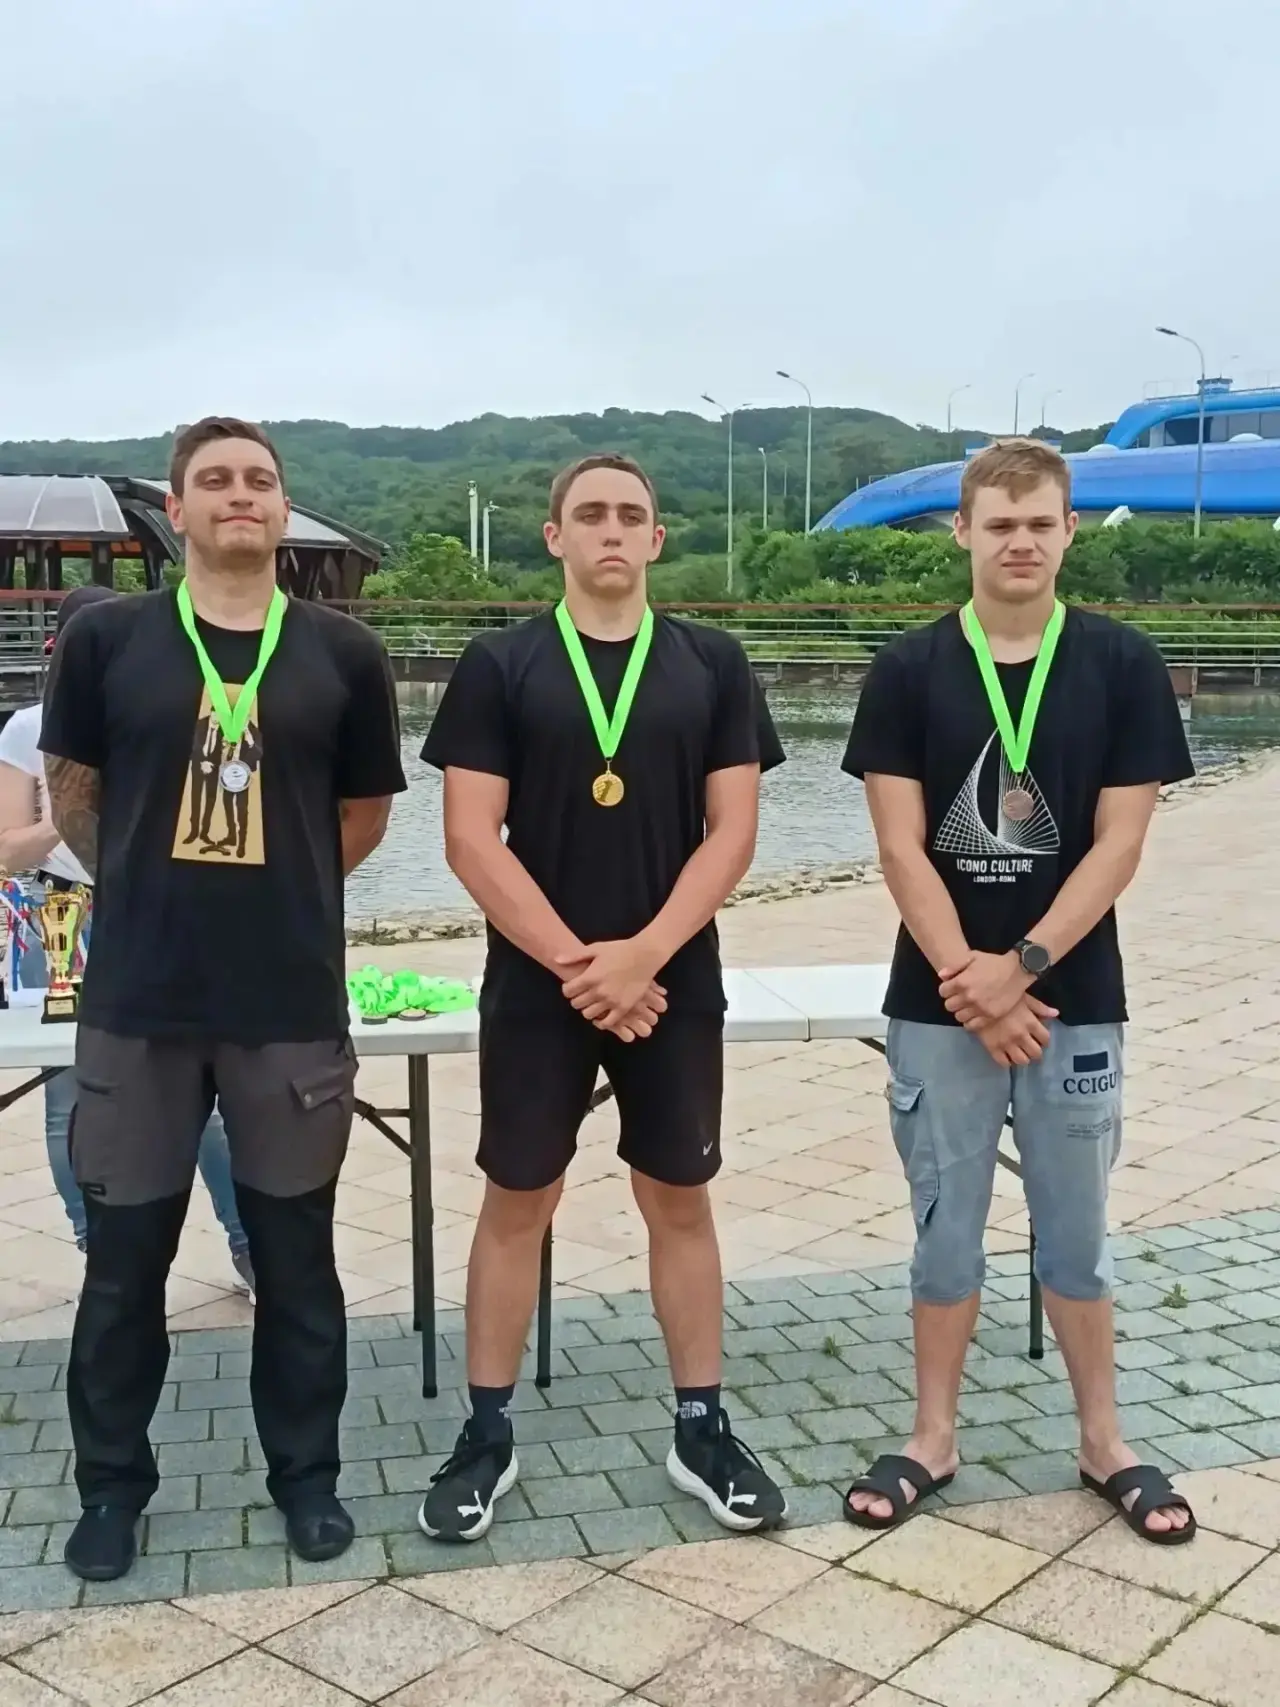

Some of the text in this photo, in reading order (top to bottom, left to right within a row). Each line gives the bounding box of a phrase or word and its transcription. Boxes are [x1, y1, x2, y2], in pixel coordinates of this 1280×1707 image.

[956, 858, 1033, 873] ICONO CULTURE
[1063, 1072, 1117, 1094] CCIGU
